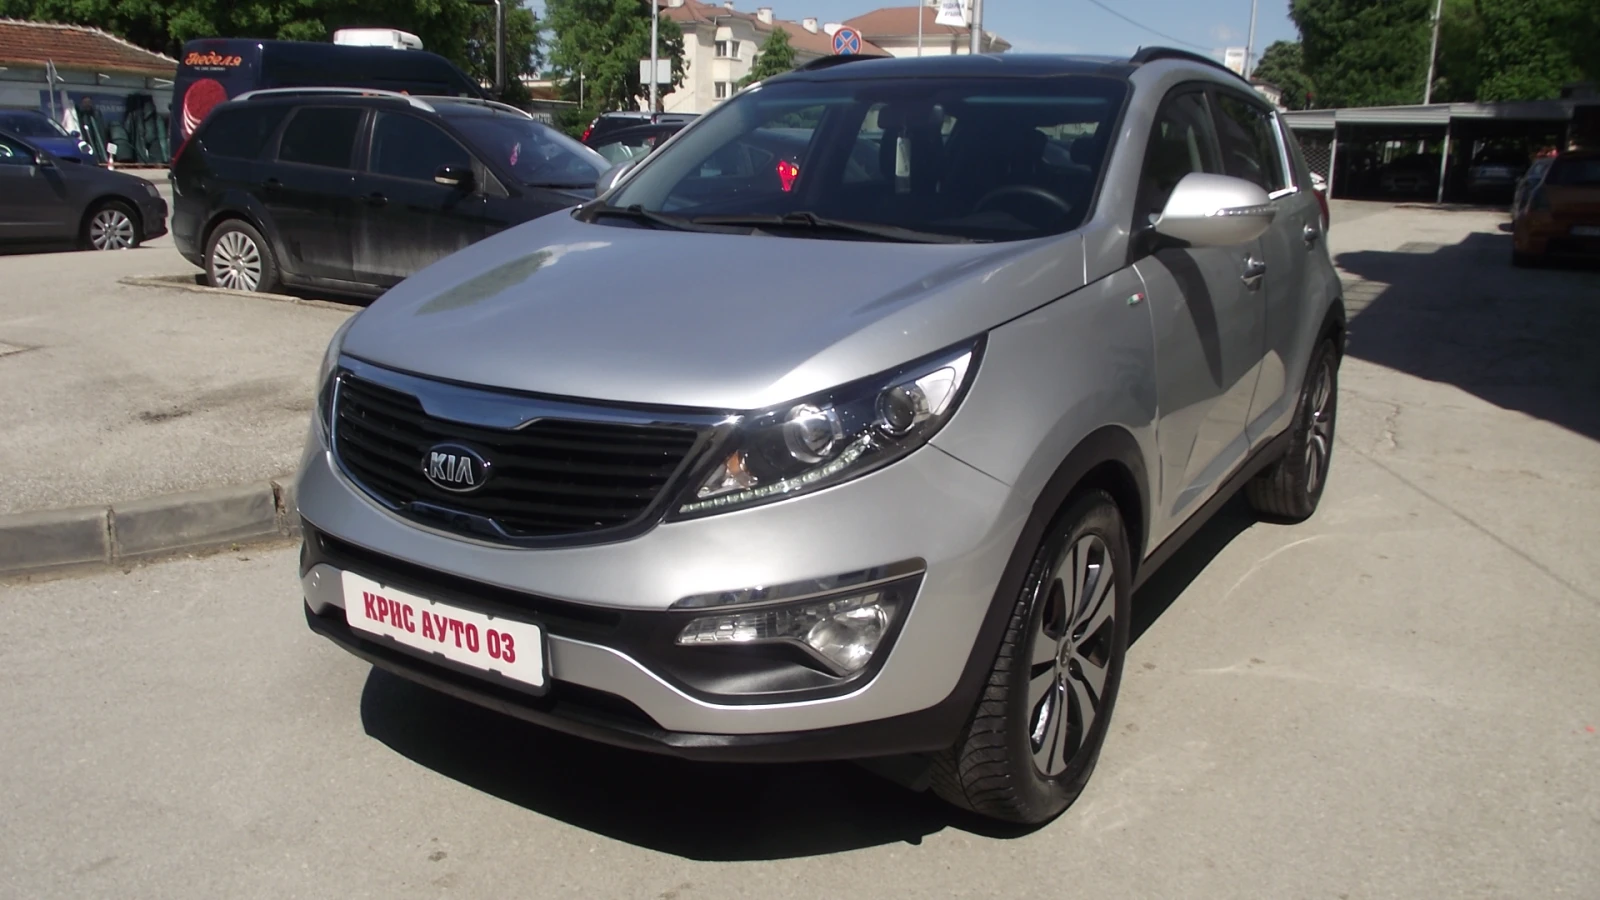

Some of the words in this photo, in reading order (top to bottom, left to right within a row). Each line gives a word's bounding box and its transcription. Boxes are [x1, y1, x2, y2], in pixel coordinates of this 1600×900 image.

[430, 451, 475, 485] KIA
[362, 591, 416, 634] КРИС
[422, 610, 480, 654] АУТО
